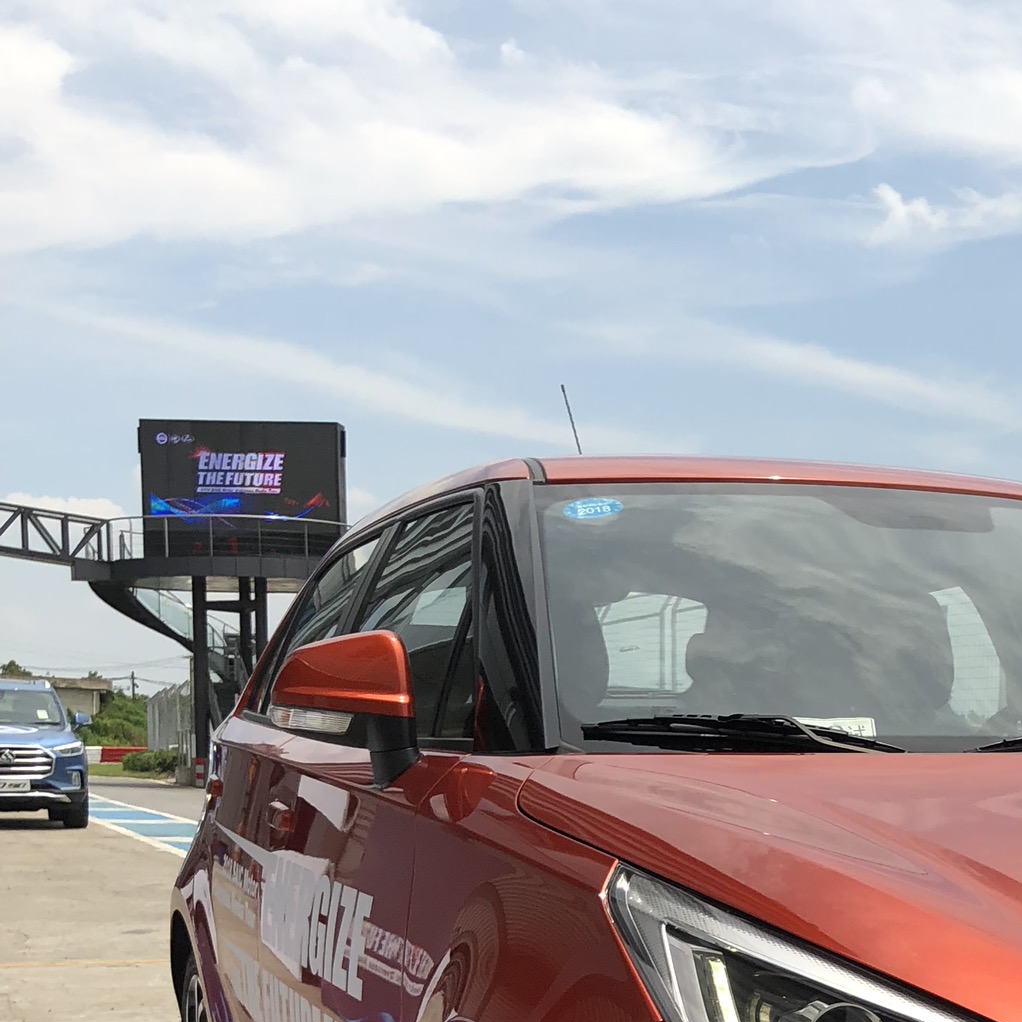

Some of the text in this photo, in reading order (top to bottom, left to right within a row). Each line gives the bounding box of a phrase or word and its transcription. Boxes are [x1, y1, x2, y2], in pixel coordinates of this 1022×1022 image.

[198, 451, 285, 470] ENERGIZE
[197, 471, 283, 487] THE FUTURE
[577, 506, 611, 516] 2018
[262, 855, 374, 1002] ENERGIZE
